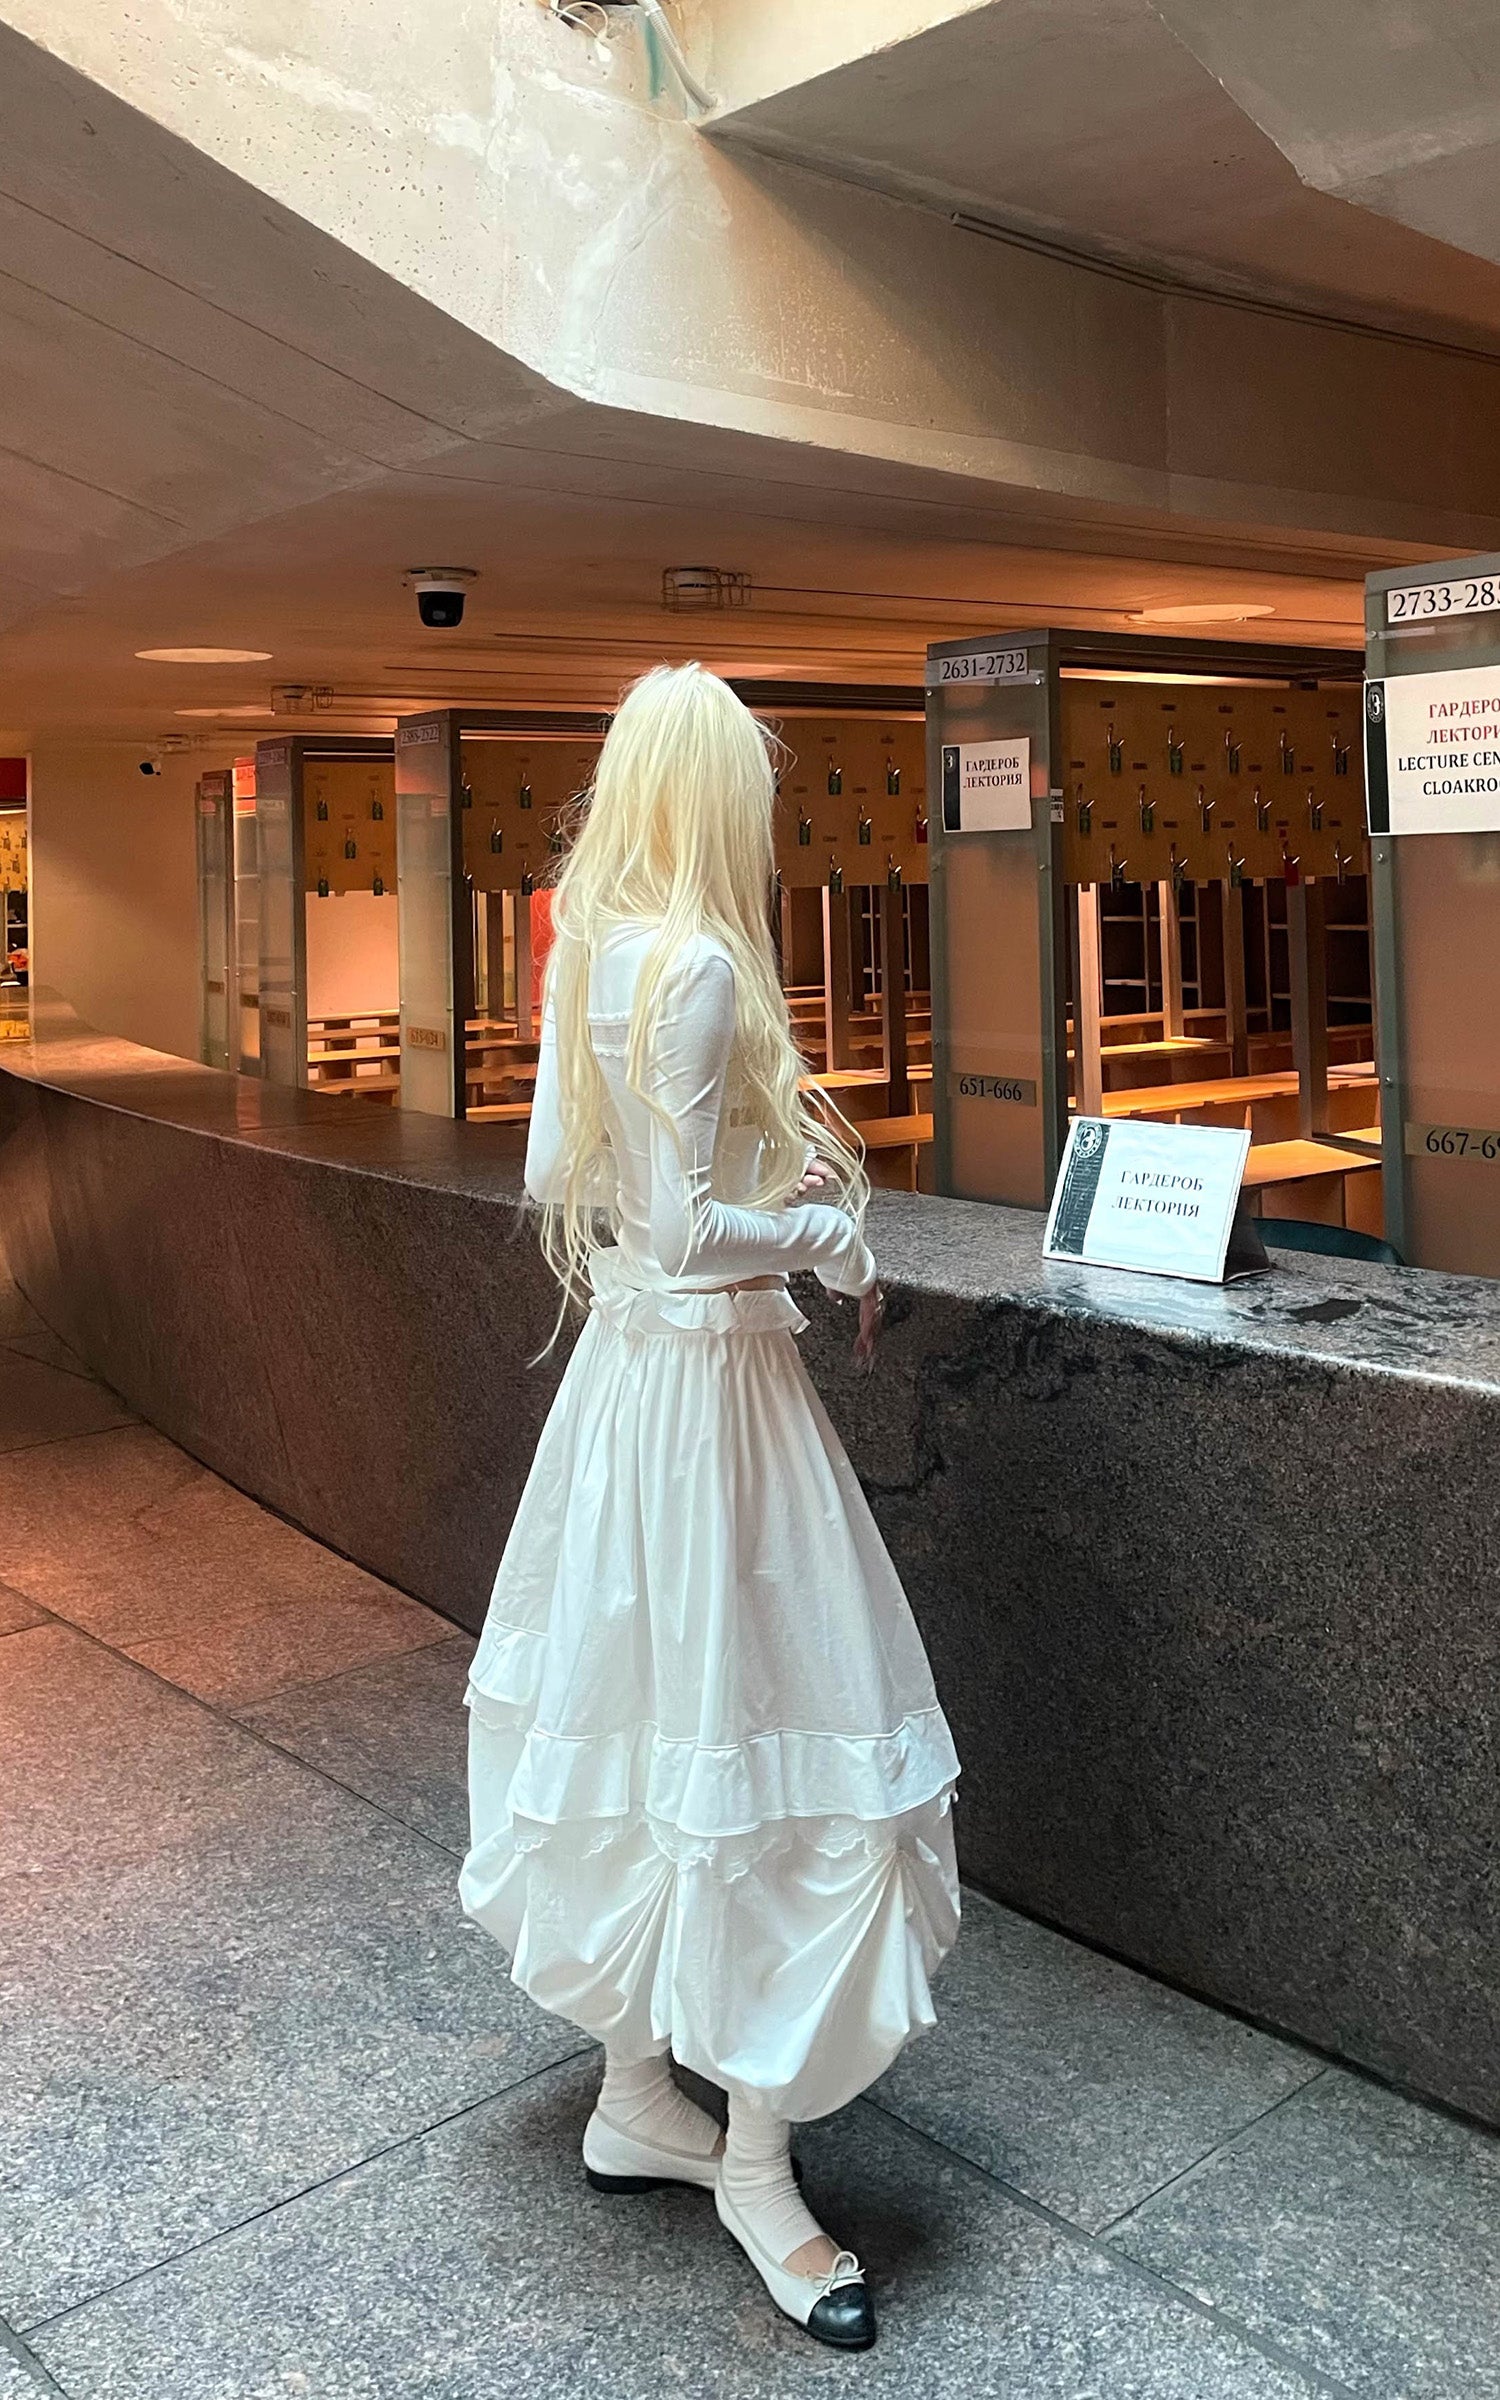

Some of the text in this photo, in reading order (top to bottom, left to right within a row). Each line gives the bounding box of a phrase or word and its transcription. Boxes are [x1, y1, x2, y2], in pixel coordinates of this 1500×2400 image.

[1393, 581, 1500, 617] 2733-28
[942, 653, 1026, 680] 2631-2732
[966, 757, 1020, 773] ГАРДЕРОБ
[1398, 753, 1469, 772] LECTURE
[963, 773, 1023, 789] ЛЕКТОРИЯ
[1423, 777, 1500, 796] CLOAKRO
[960, 1076, 1022, 1102] 651-666
[1120, 1170, 1204, 1192] ГАРДЕРОБ
[1111, 1196, 1201, 1219] ЛЕКТОРИЯ
